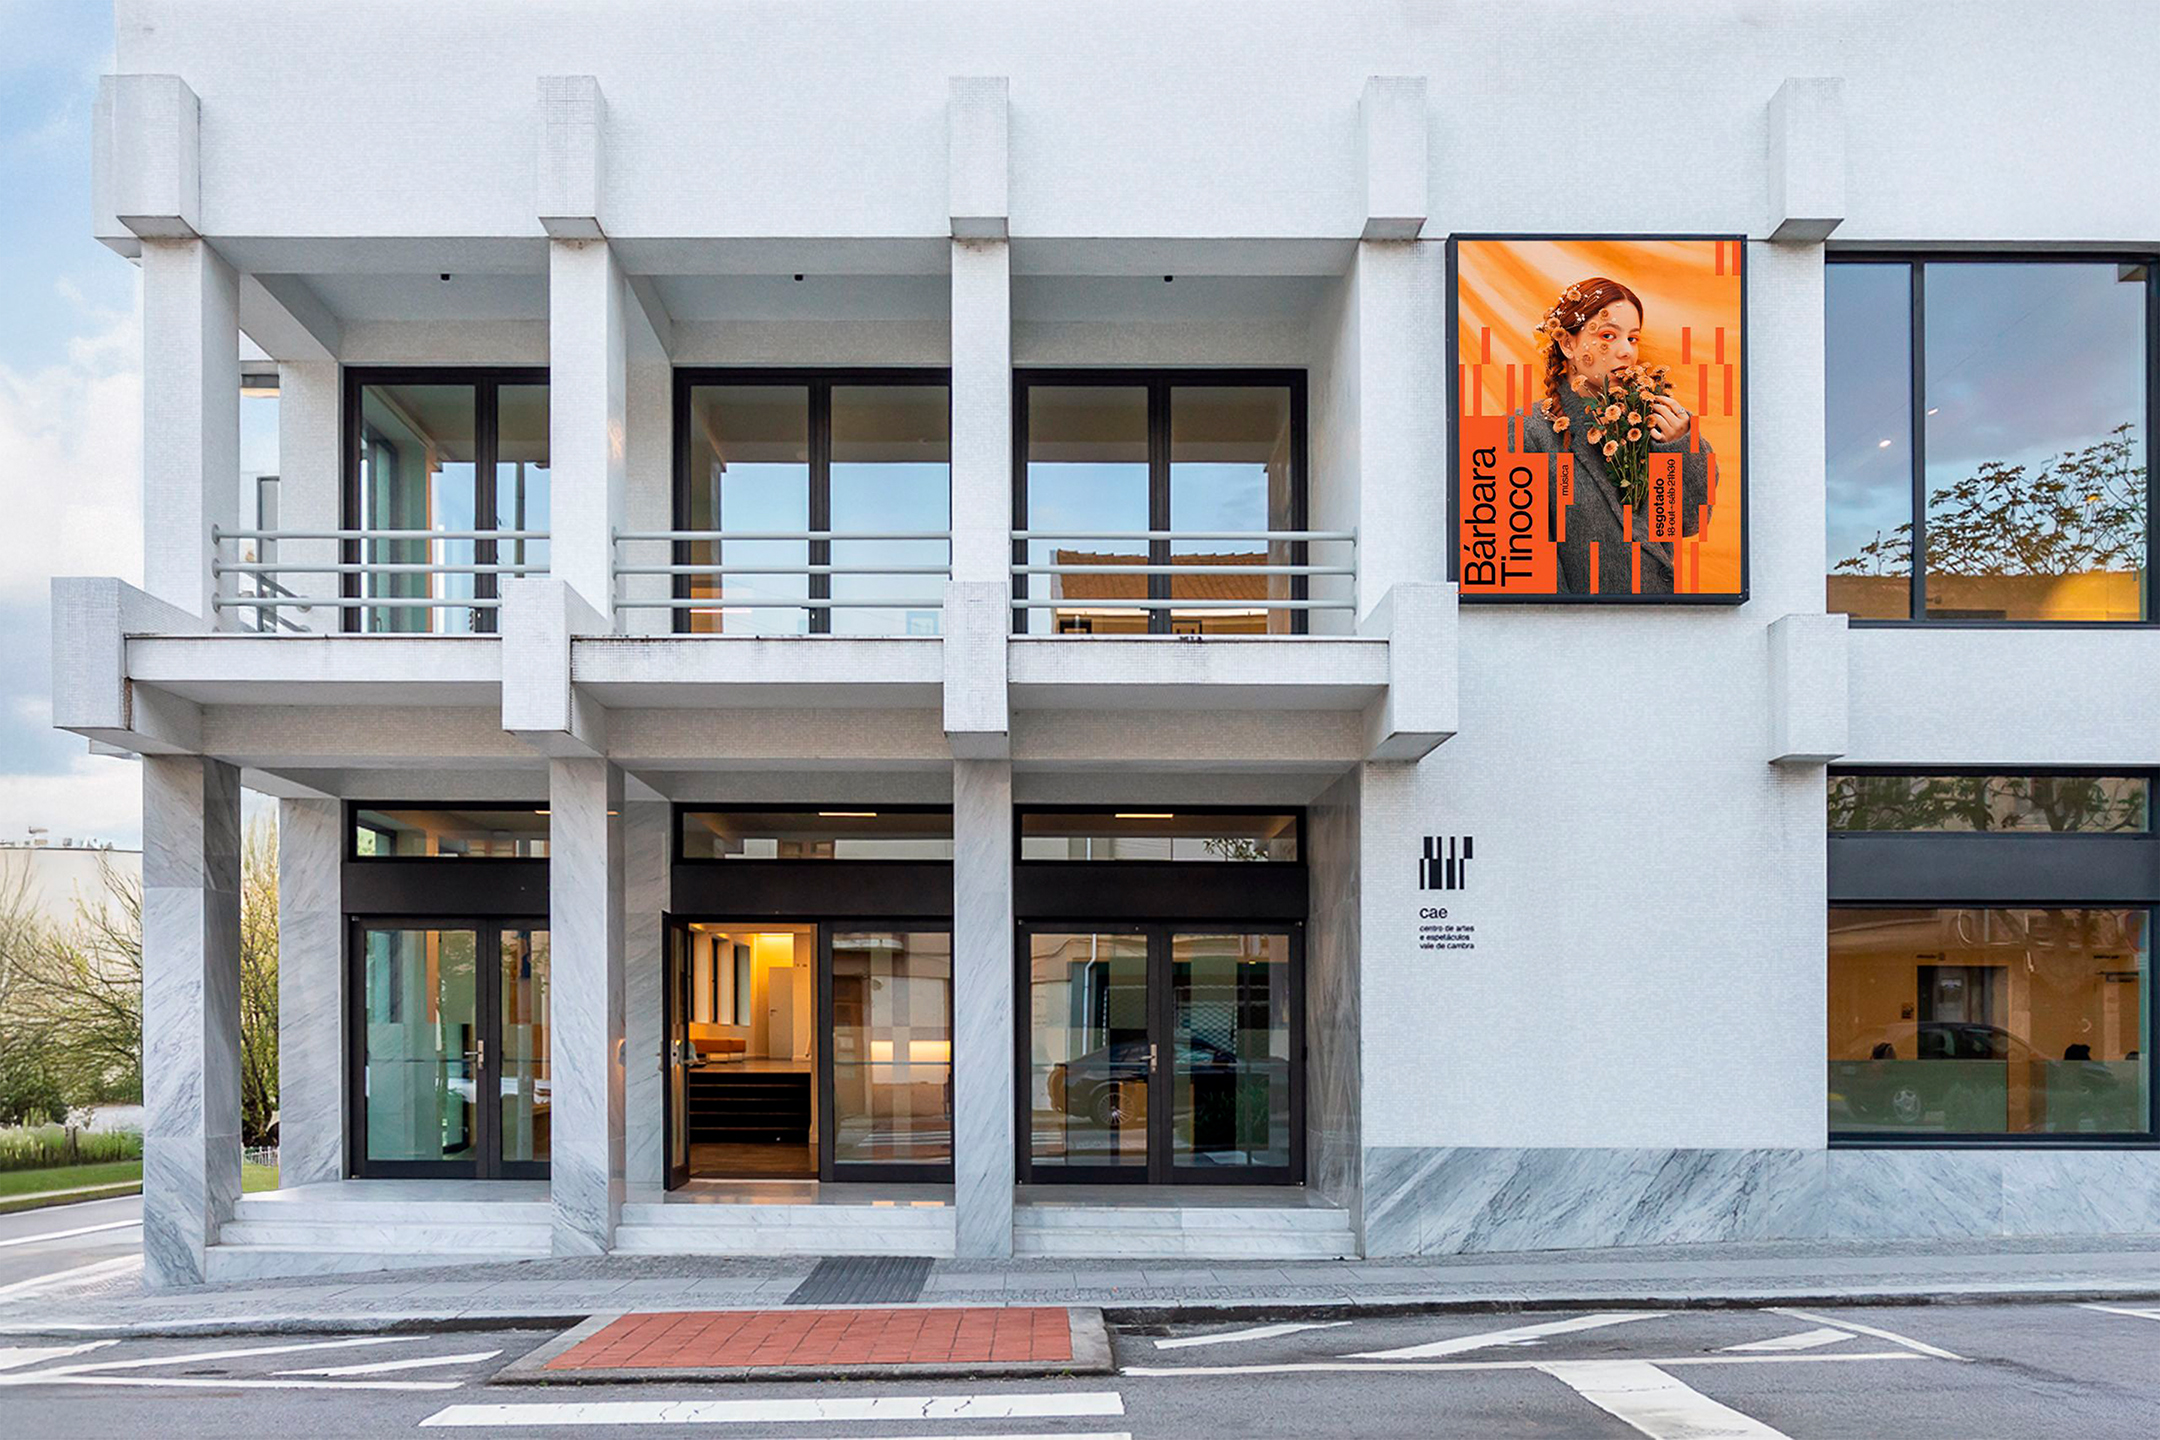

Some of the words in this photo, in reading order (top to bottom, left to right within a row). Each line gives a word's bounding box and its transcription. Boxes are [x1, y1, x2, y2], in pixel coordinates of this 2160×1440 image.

[1560, 464, 1570, 497] música
[1666, 458, 1676, 487] 21h30
[1666, 487, 1676, 505] sáb
[1463, 446, 1497, 586] Bárbara
[1653, 478, 1667, 538] esgotado
[1500, 466, 1534, 588] Tinoco
[1666, 510, 1676, 526] out
[1666, 526, 1676, 537] 18
[1419, 907, 1448, 919] cae
[1419, 924, 1444, 932] centro
[1445, 924, 1454, 932] de
[1426, 933, 1470, 942] espetáculos
